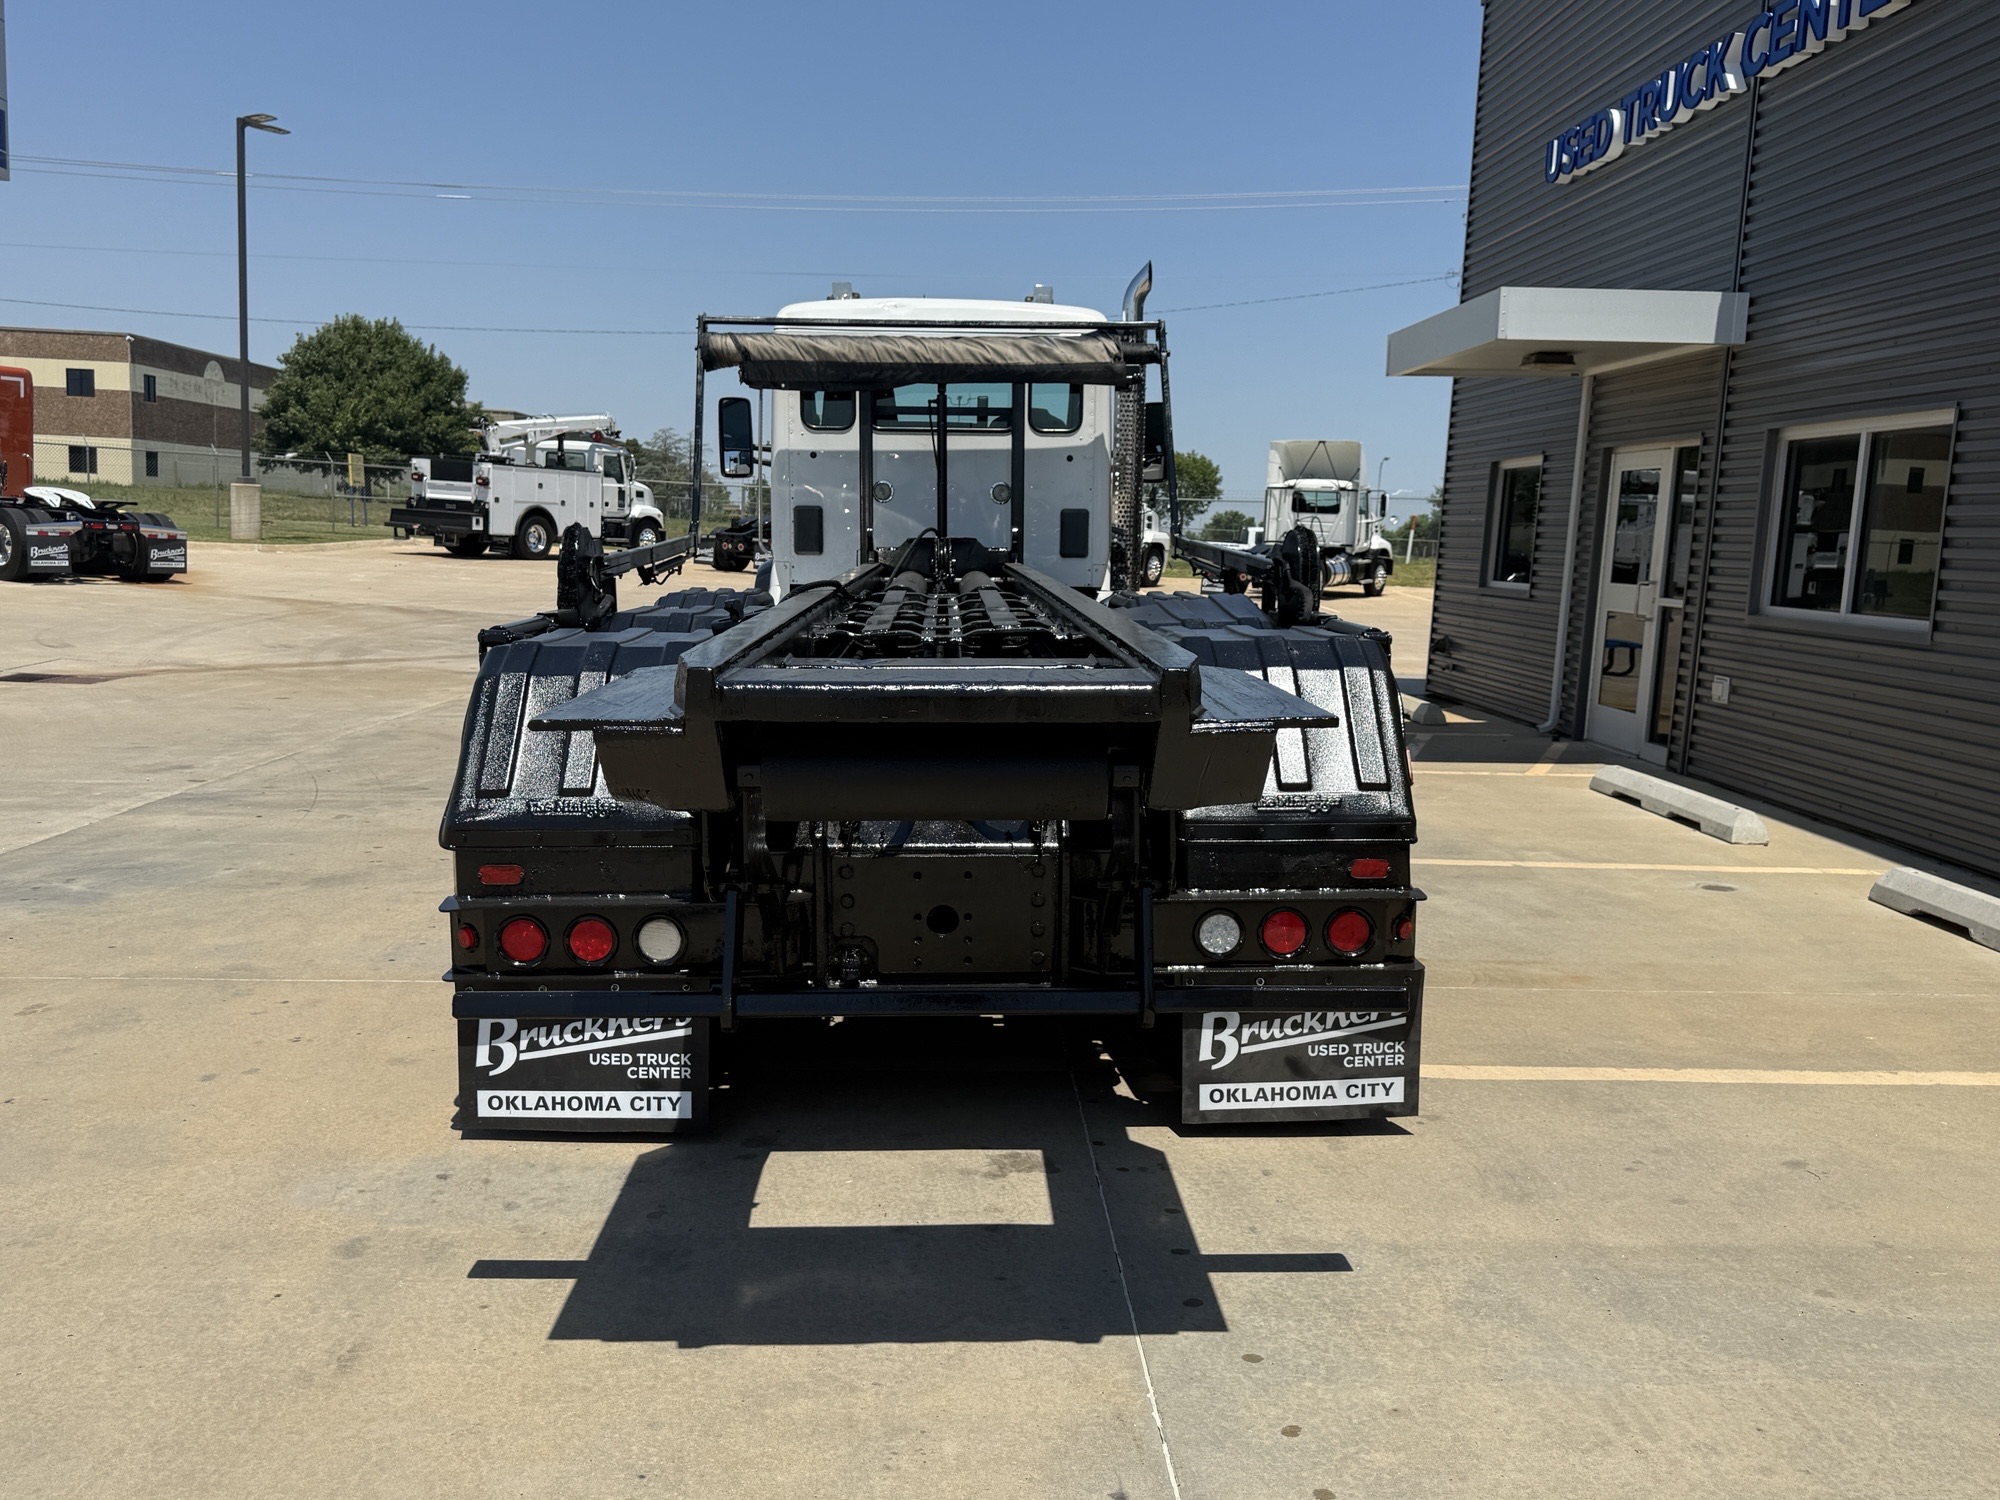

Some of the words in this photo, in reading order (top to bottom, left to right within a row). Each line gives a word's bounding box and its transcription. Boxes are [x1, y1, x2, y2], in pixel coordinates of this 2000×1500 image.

[1545, 108, 1617, 184] USED
[1621, 33, 1738, 145] TRUCK
[1741, 0, 1896, 77] CEN
[1308, 1044, 1349, 1057] USED
[1353, 1041, 1406, 1055] TRUCK
[589, 1053, 633, 1065] USED
[636, 1053, 692, 1065] TRUCK
[1343, 1054, 1405, 1068] CENTER
[626, 1066, 692, 1079] CENTER
[1209, 1085, 1338, 1104] OKLAHOMA
[1345, 1081, 1396, 1099] CITY
[487, 1095, 622, 1111] OKLAHOMA
[629, 1096, 682, 1111] CITY
